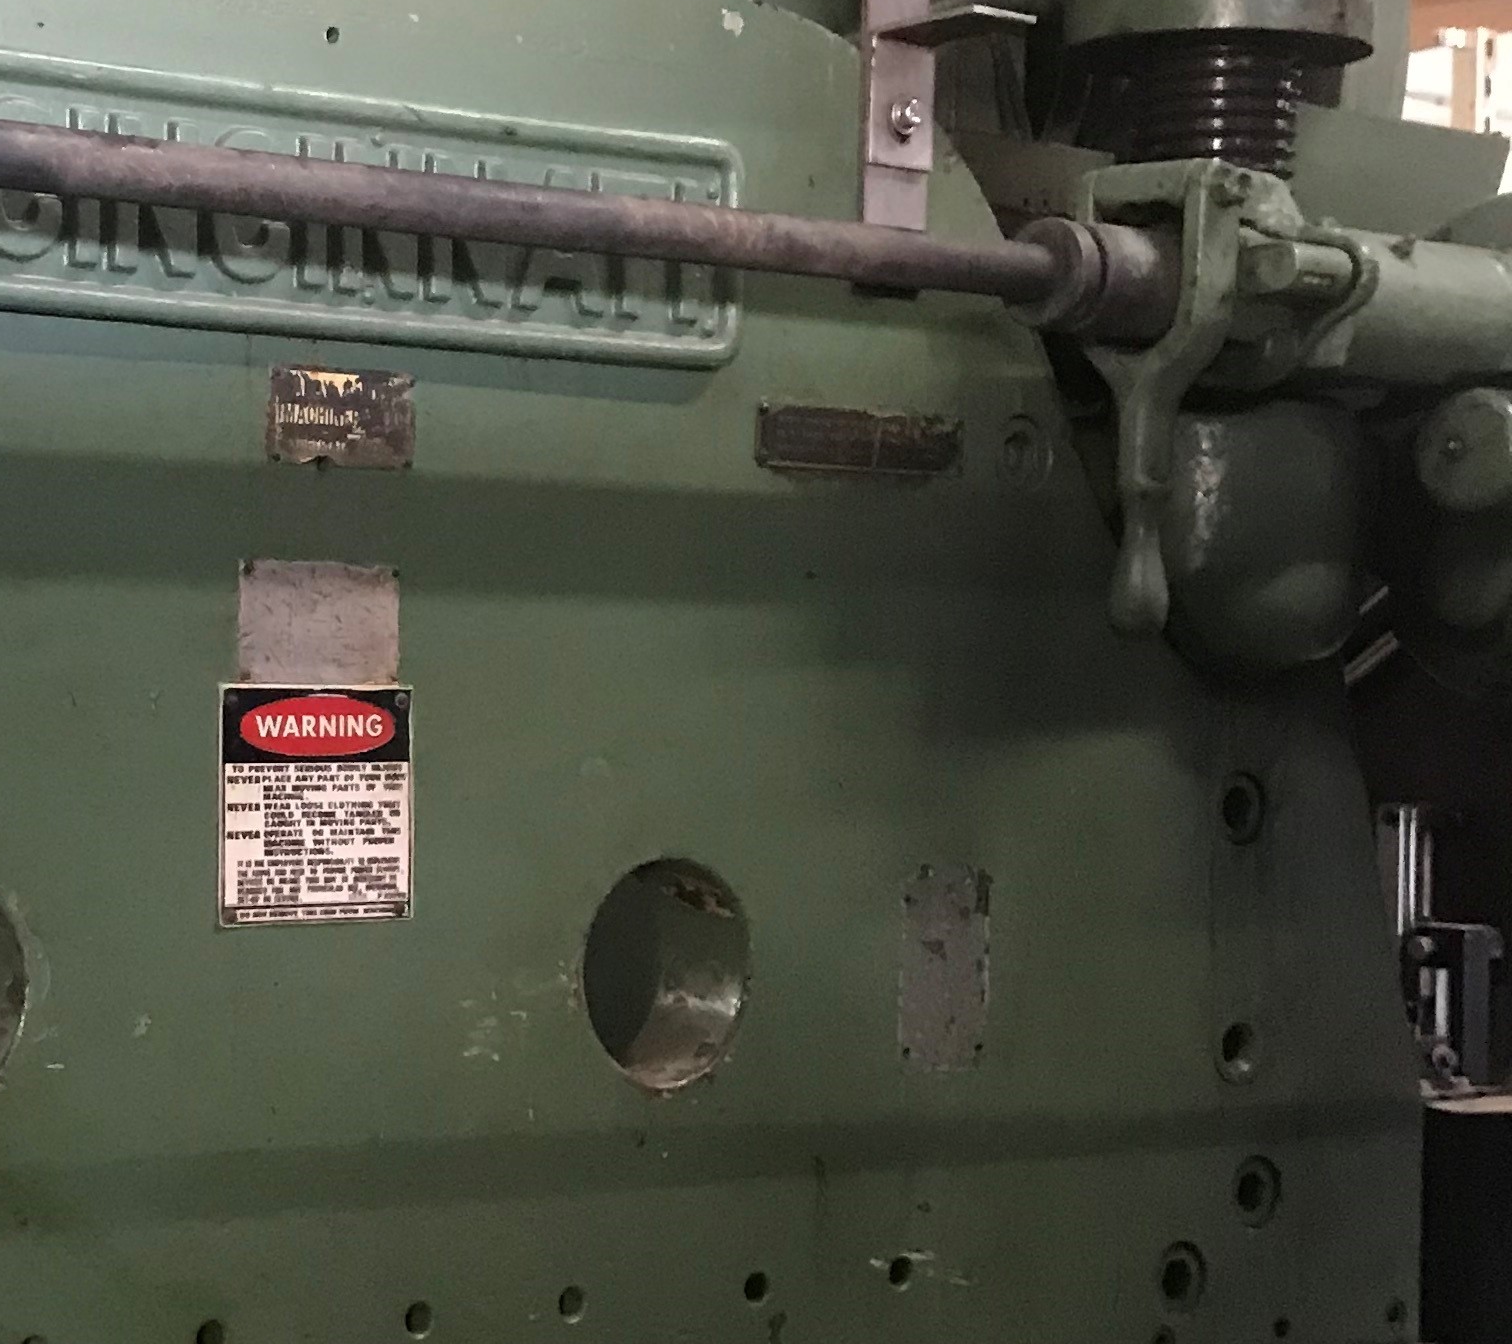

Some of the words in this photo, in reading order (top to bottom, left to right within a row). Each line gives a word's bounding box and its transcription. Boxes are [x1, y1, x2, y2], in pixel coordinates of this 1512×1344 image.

[255, 713, 384, 739] WARNING
[227, 776, 260, 784] NEVER
[262, 775, 291, 783] PLACE
[317, 774, 340, 782] PART
[332, 783, 360, 791] PARTS
[227, 803, 260, 811] NEVER
[264, 802, 290, 810] WEAR
[328, 801, 373, 809] CLOTHING
[226, 831, 260, 839] NEVER
[264, 829, 303, 837] OPERATE
